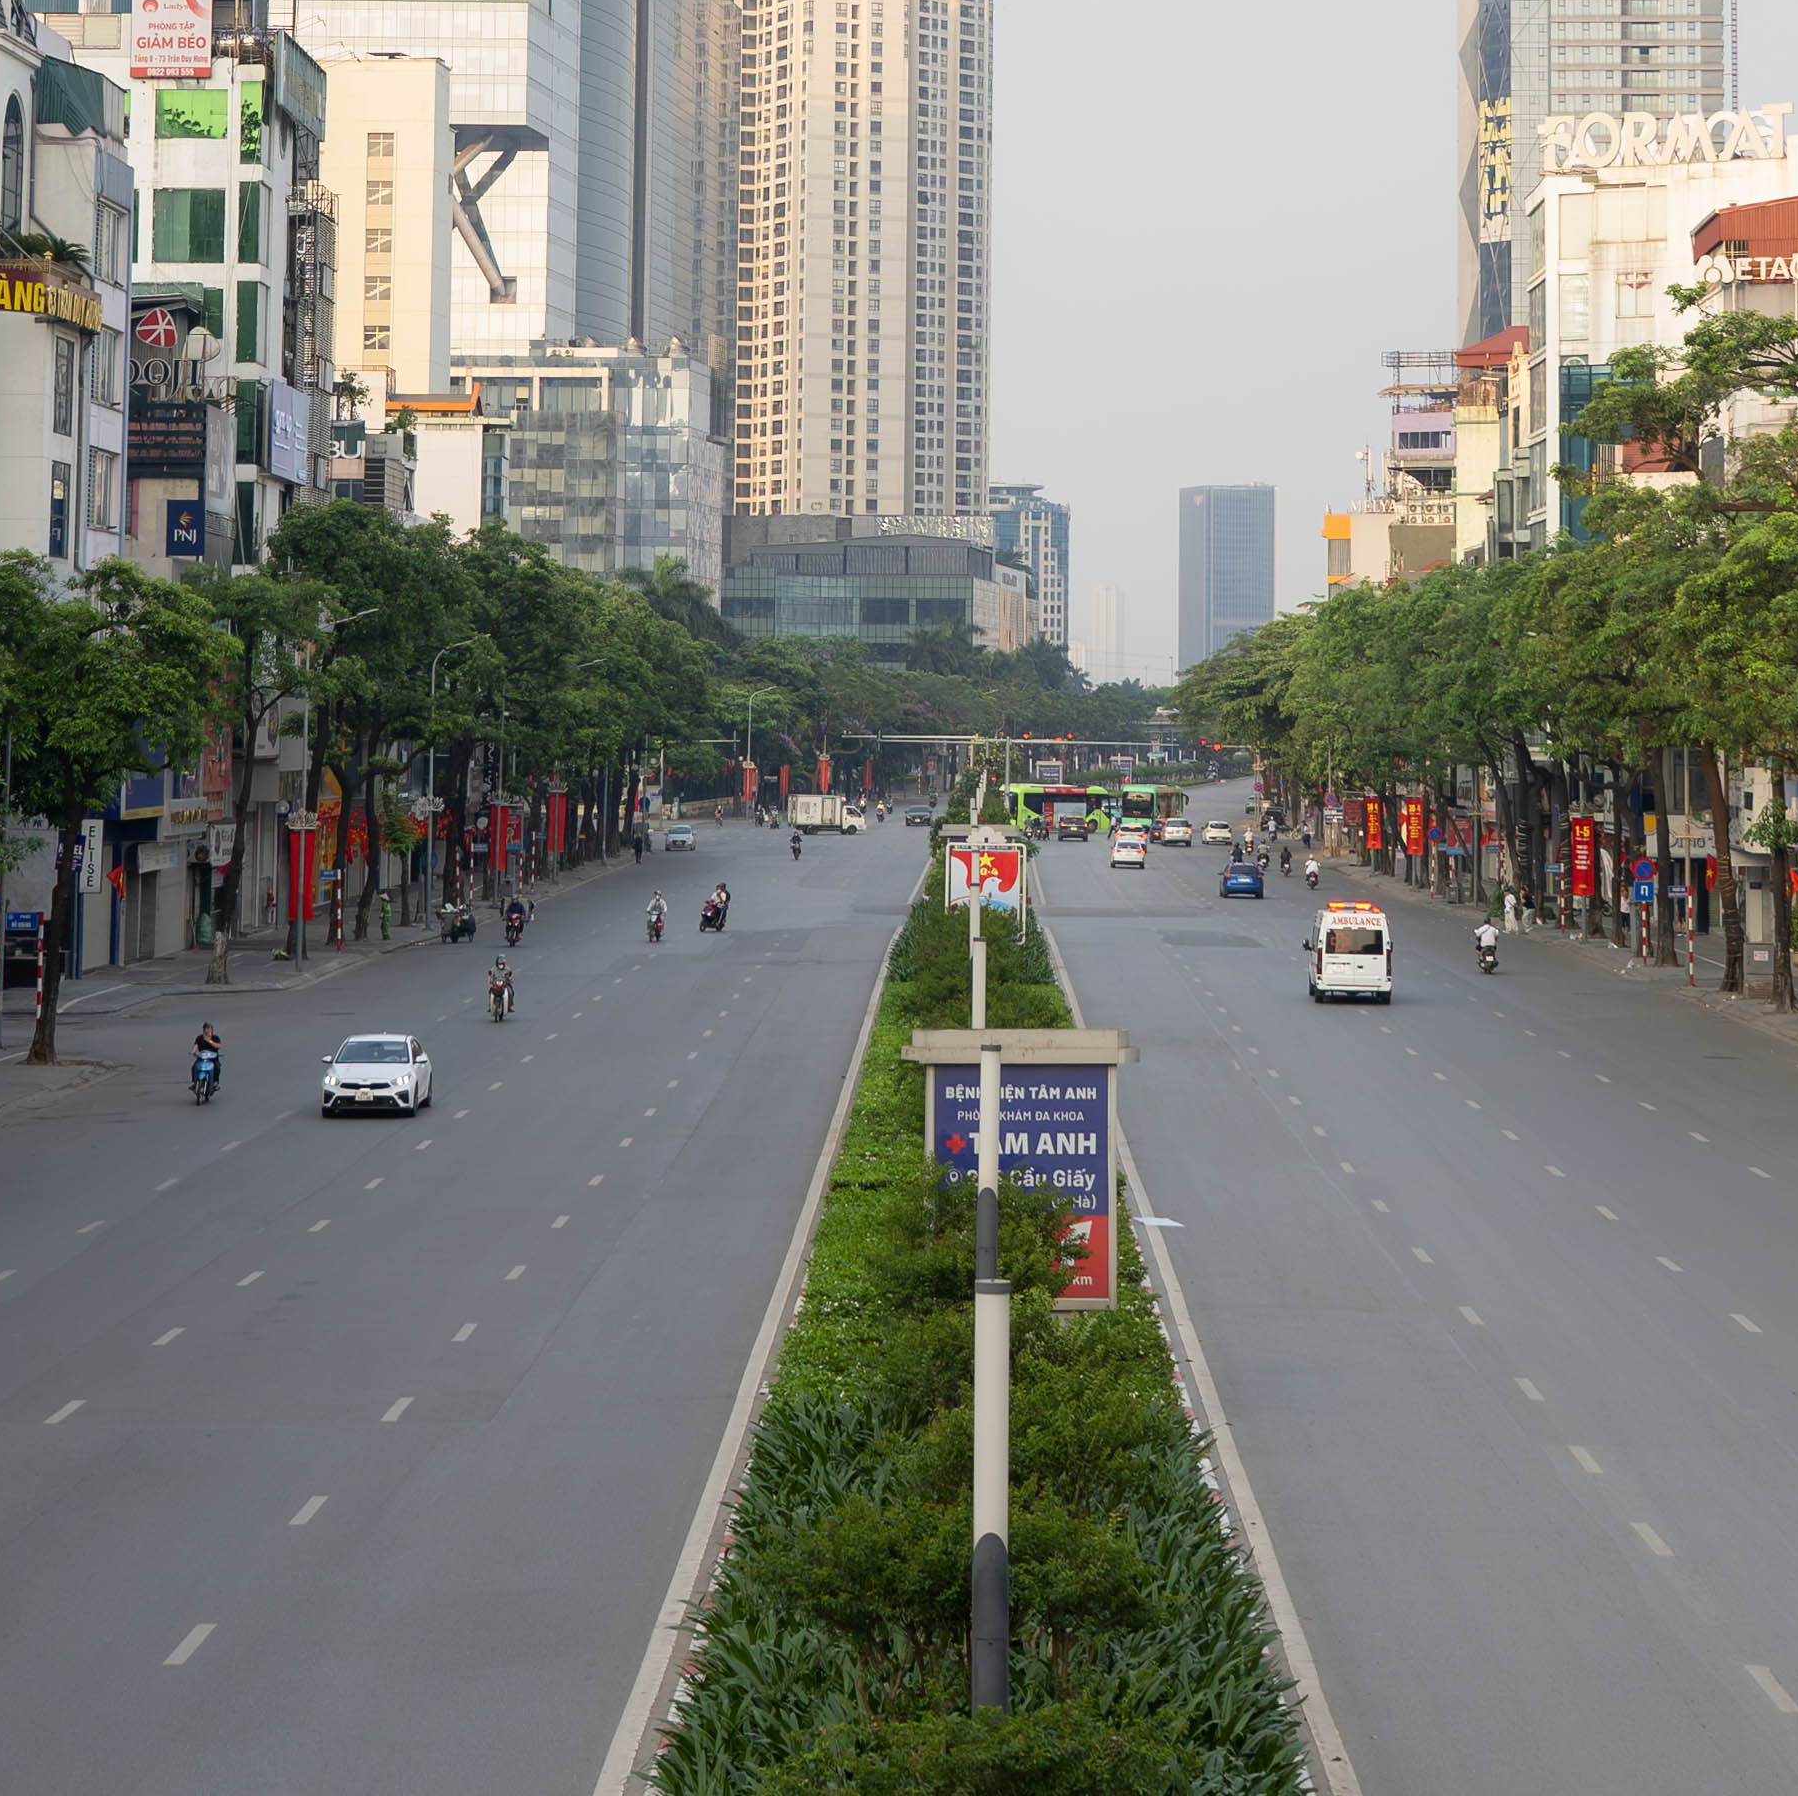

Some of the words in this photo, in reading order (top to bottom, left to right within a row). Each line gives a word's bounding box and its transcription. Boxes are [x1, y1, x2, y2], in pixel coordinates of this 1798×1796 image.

[136, 32, 173, 49] GIẢM
[178, 32, 207, 49] BÉO
[173, 528, 197, 545] PNJ
[87, 826, 96, 887] ELISE
[1331, 916, 1381, 926] AMBULANCE
[1001, 1083, 1025, 1103] IỆN
[1028, 1084, 1061, 1100] TÂM
[1065, 1086, 1097, 1100] ANH
[957, 1108, 980, 1122] PHÒ
[1000, 1108, 1032, 1122] KHÁM
[1034, 1111, 1050, 1122] ĐA
[1053, 1111, 1084, 1122] KHOA
[969, 1132, 1029, 1154] TM
[1036, 1132, 1097, 1154] ANH
[1052, 1167, 1096, 1191] Giấy
[1072, 1275, 1093, 1286] km
